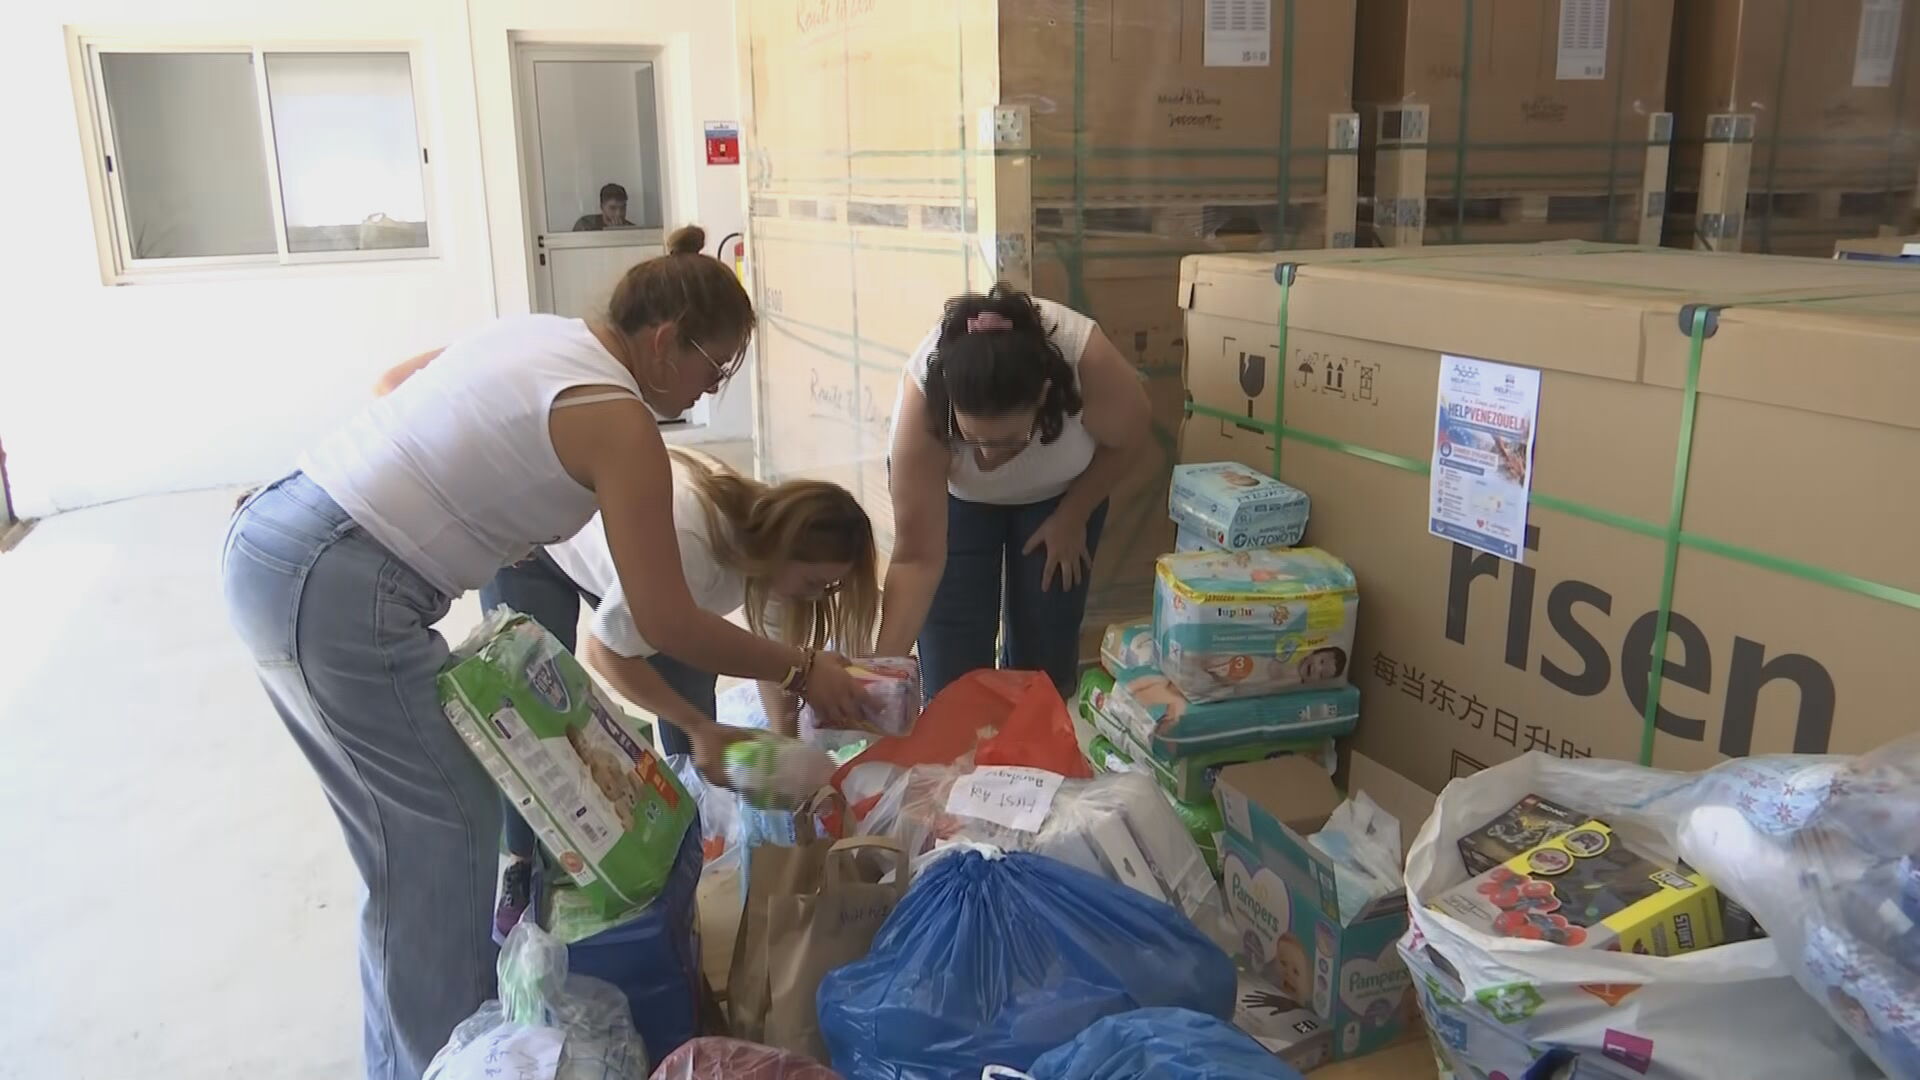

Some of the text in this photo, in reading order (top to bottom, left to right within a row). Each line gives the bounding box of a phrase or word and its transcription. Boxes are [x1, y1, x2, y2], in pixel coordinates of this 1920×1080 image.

[1234, 656, 1245, 669] 3
[1445, 526, 1836, 758] risen
[1232, 872, 1280, 933] Pampers
